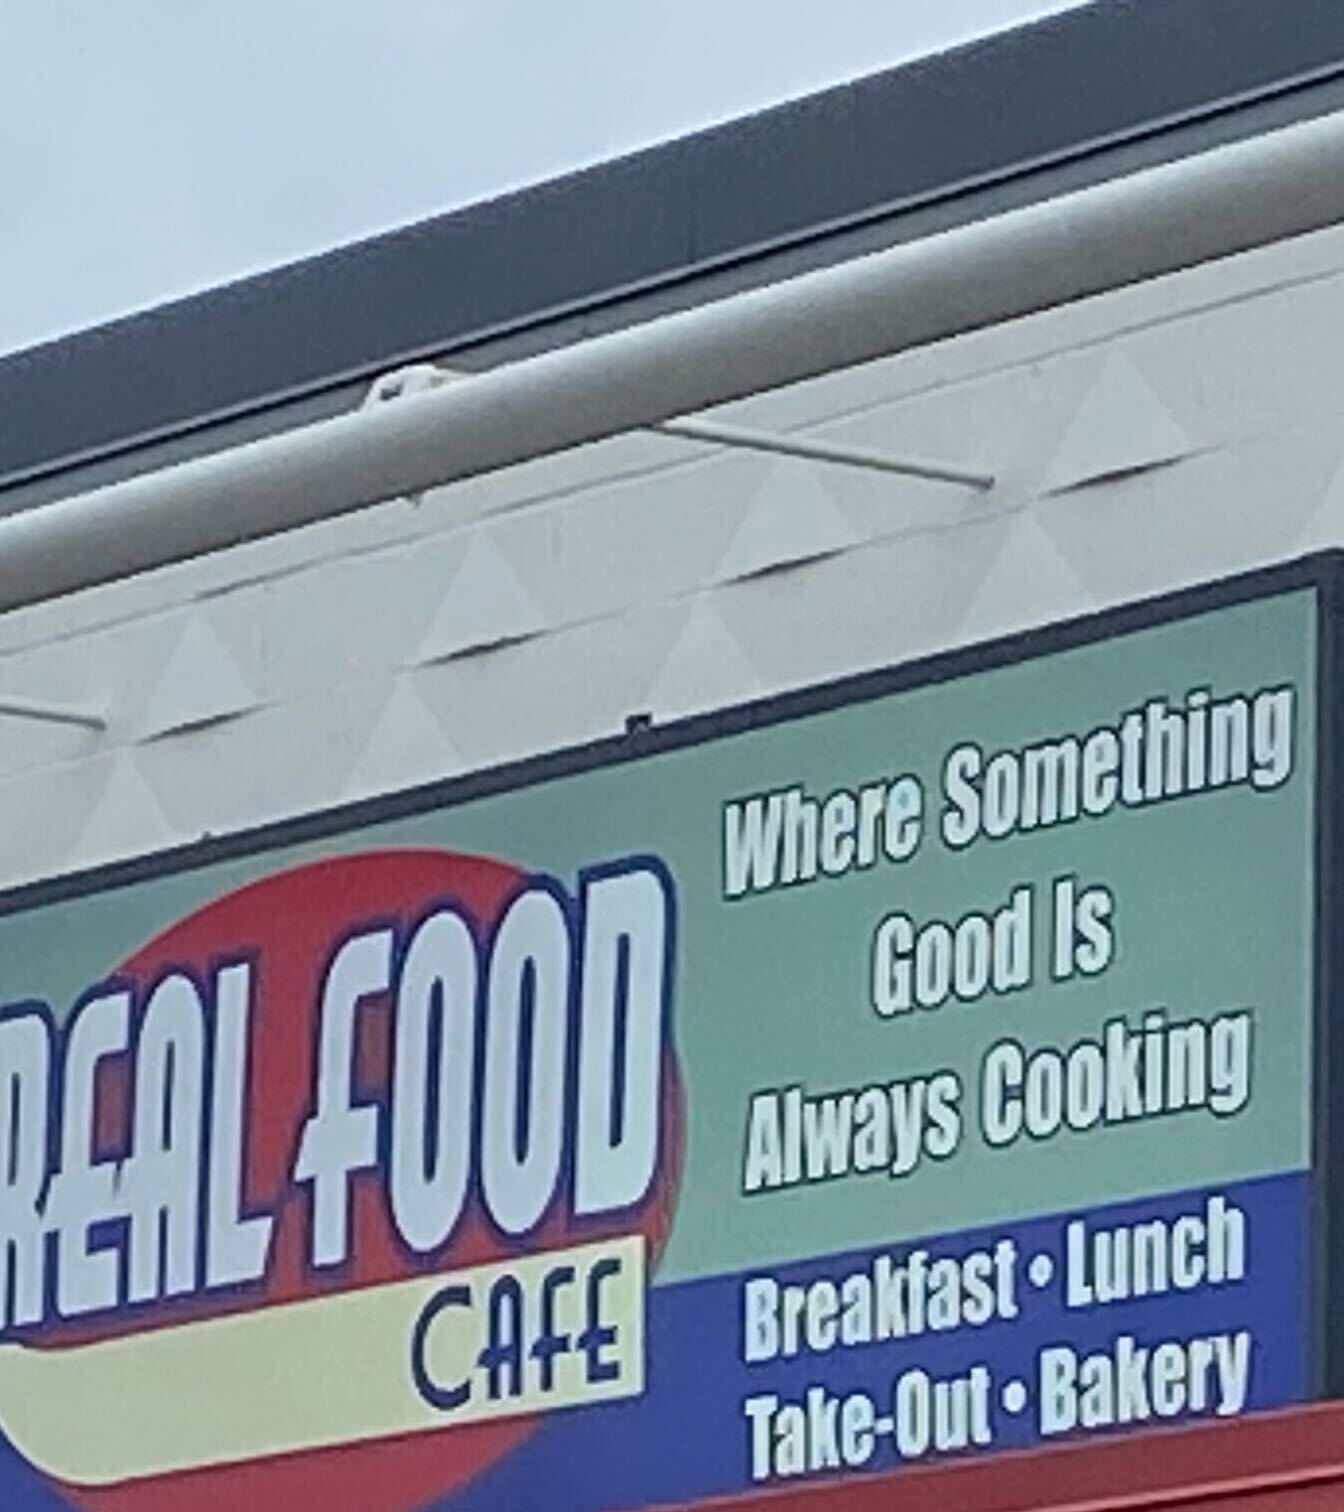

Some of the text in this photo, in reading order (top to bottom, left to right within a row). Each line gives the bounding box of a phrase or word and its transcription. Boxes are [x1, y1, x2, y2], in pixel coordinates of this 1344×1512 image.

[723, 687, 1295, 900] Where Something
[872, 876, 1114, 1019] Good Is
[292, 864, 670, 1270] FOOD
[743, 1010, 1253, 1196] Always Cooking
[411, 1257, 622, 1411] CAFE
[744, 1195, 1246, 1364] Breakfast Lunch
[746, 1330, 1252, 1481] Take-Out Bakery
